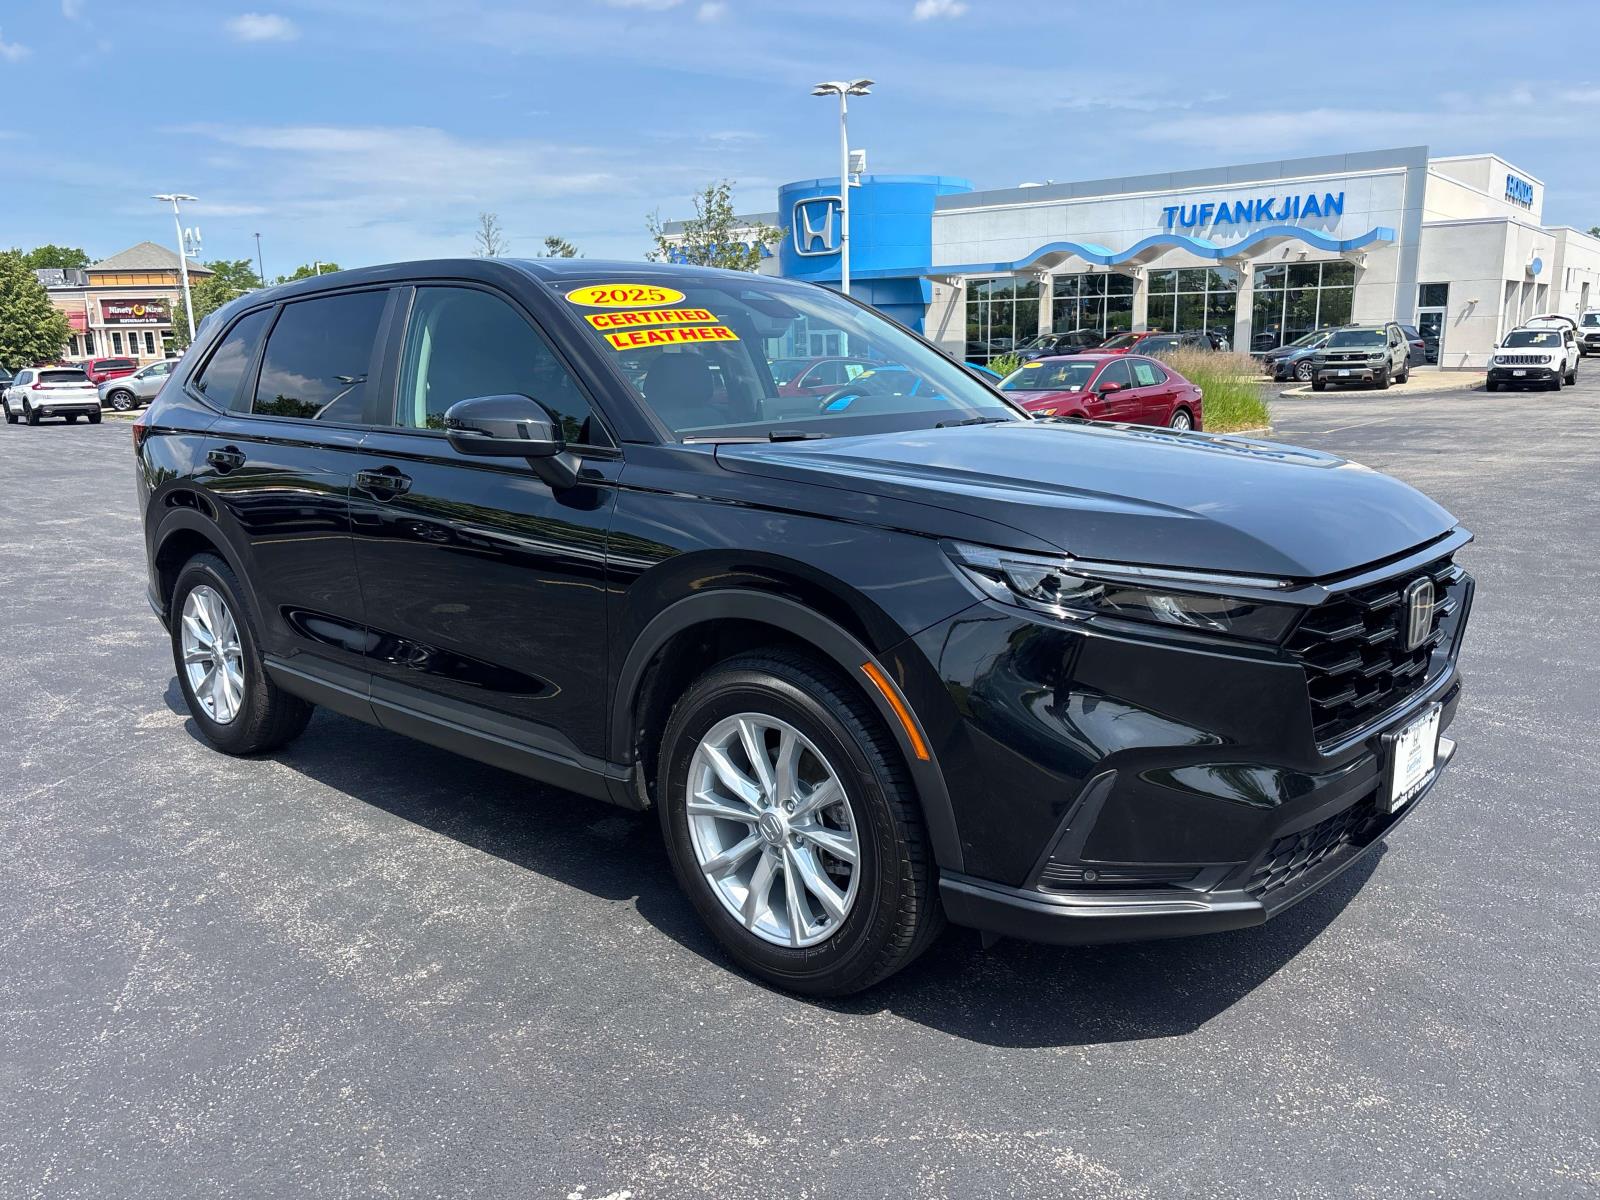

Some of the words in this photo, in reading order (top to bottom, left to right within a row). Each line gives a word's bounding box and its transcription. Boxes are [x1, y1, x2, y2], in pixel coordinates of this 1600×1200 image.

[1163, 191, 1345, 228] TUFANKJIAN
[591, 289, 666, 304] 2025
[108, 305, 132, 314] Ninety
[145, 304, 163, 313] Nine
[592, 310, 711, 328] CERTIFIED
[612, 327, 733, 348] LEATHER
